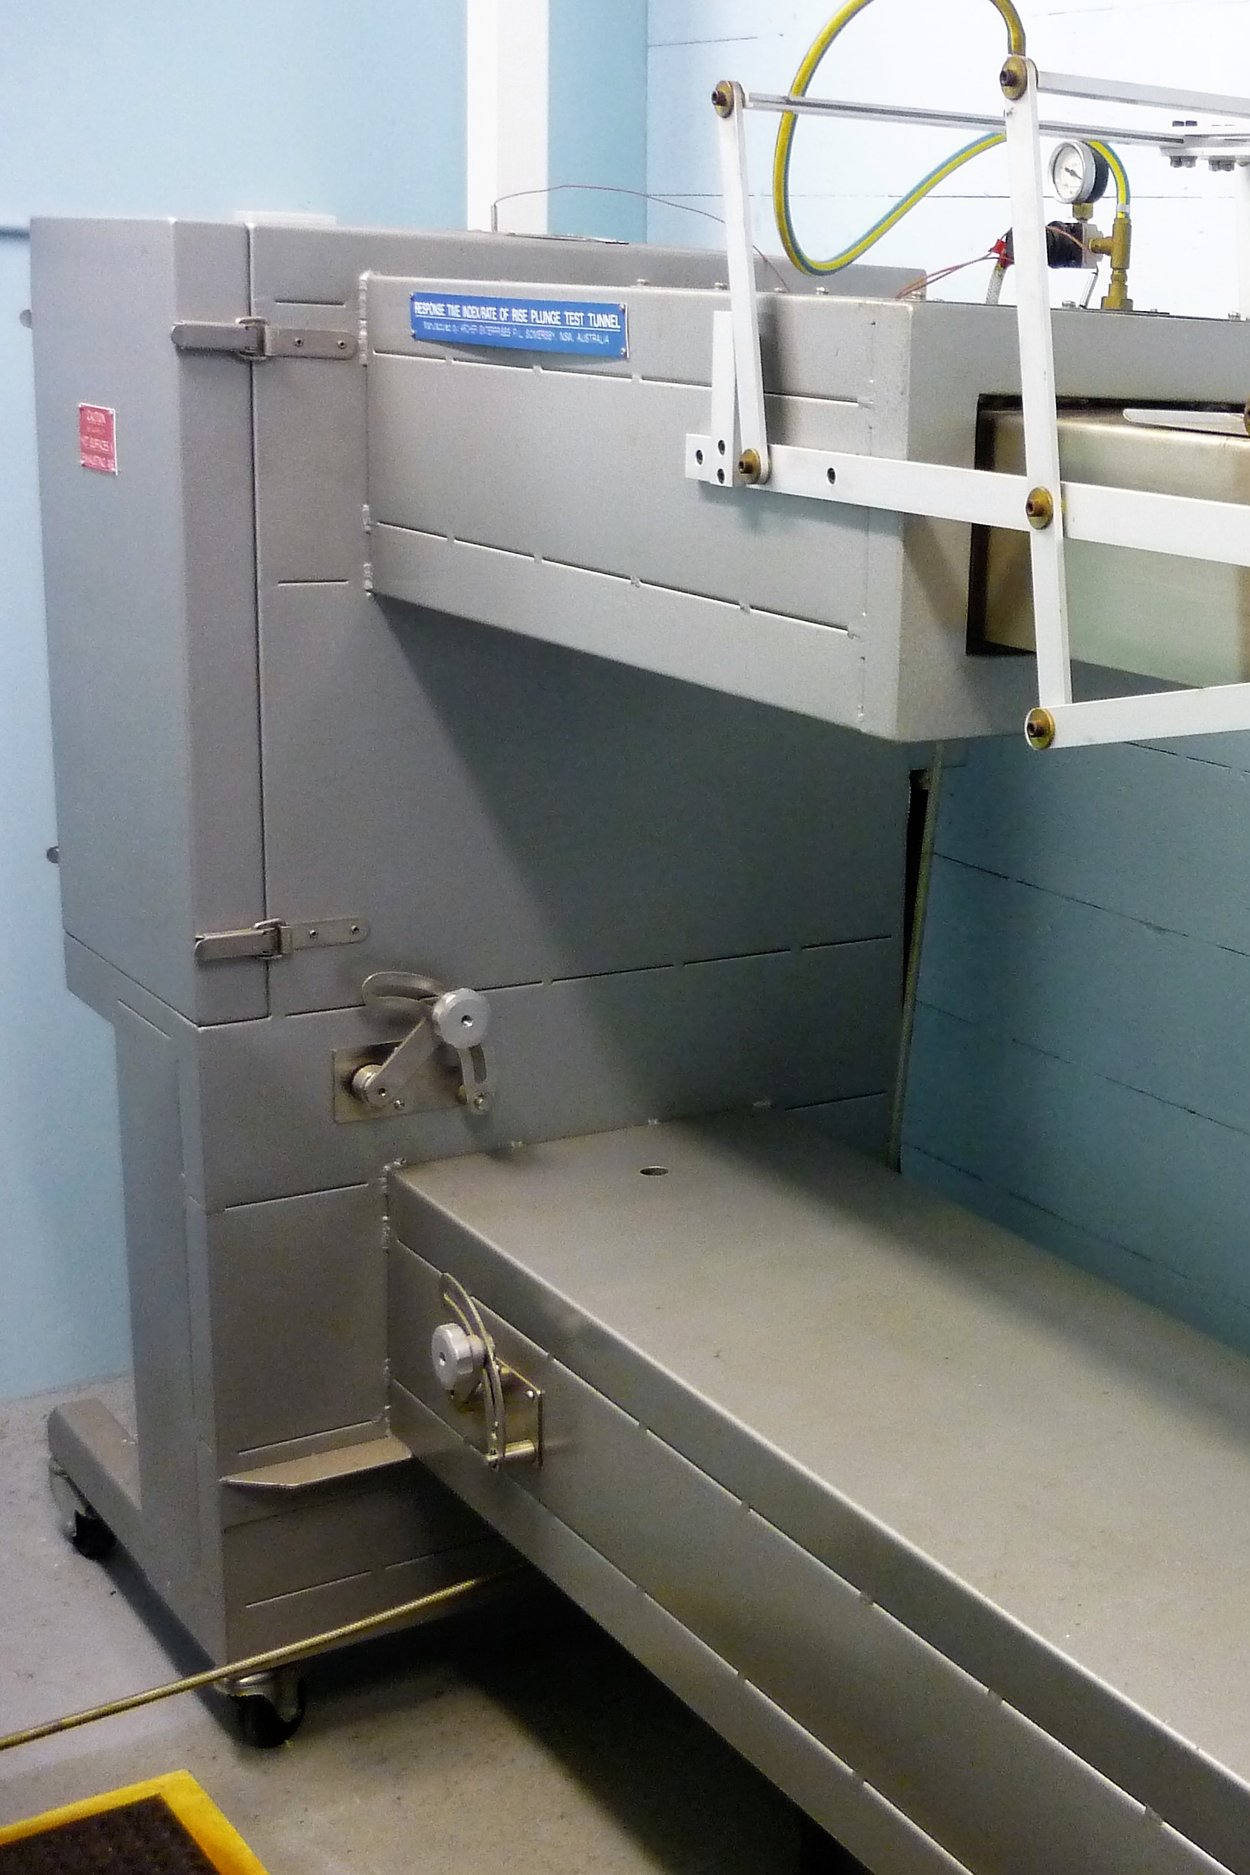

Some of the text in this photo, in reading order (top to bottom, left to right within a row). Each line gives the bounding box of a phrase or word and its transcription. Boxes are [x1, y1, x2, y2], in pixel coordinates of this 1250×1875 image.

[414, 301, 446, 316] RESPONSE
[499, 307, 510, 321] OF
[511, 308, 528, 323] RISE
[530, 309, 561, 325] PLUNGE
[564, 311, 584, 326] TEST
[587, 312, 620, 329] TUNNEL
